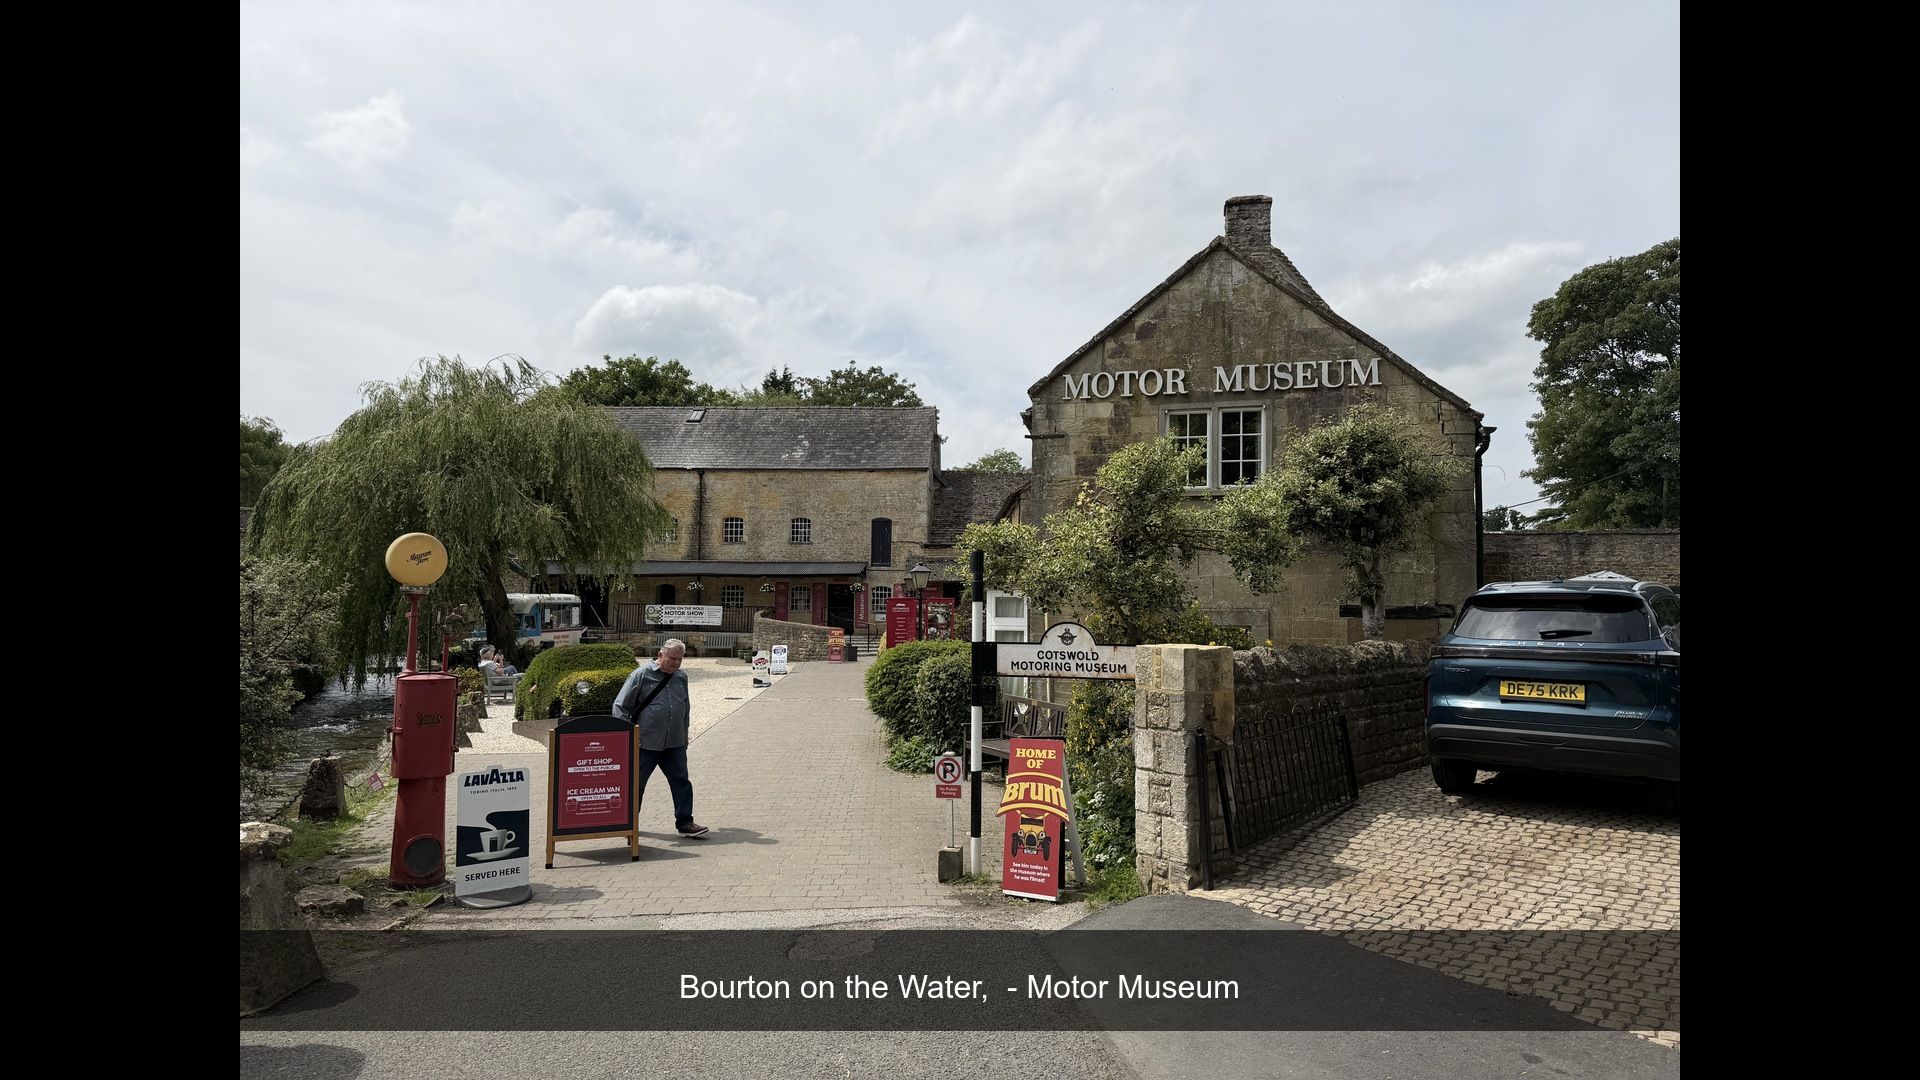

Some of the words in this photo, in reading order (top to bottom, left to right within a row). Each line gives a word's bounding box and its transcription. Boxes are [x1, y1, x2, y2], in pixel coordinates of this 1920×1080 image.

[1062, 368, 1188, 400] MOTOR
[1212, 357, 1382, 393] MUSEUM
[1037, 650, 1099, 661] COTSWOLD
[1011, 661, 1072, 671] MOTORING
[1075, 662, 1127, 673] MUSEUM
[1507, 682, 1545, 696] DE75
[1549, 685, 1578, 698] KRK
[1015, 748, 1056, 759] HOME
[593, 757, 613, 765] SHOP
[1026, 758, 1044, 769] OF
[567, 788, 579, 796] ICE
[579, 787, 606, 795] CREAM
[1001, 781, 1067, 810] Brum
[465, 870, 498, 882] SERVED
[499, 866, 521, 877] HERE
